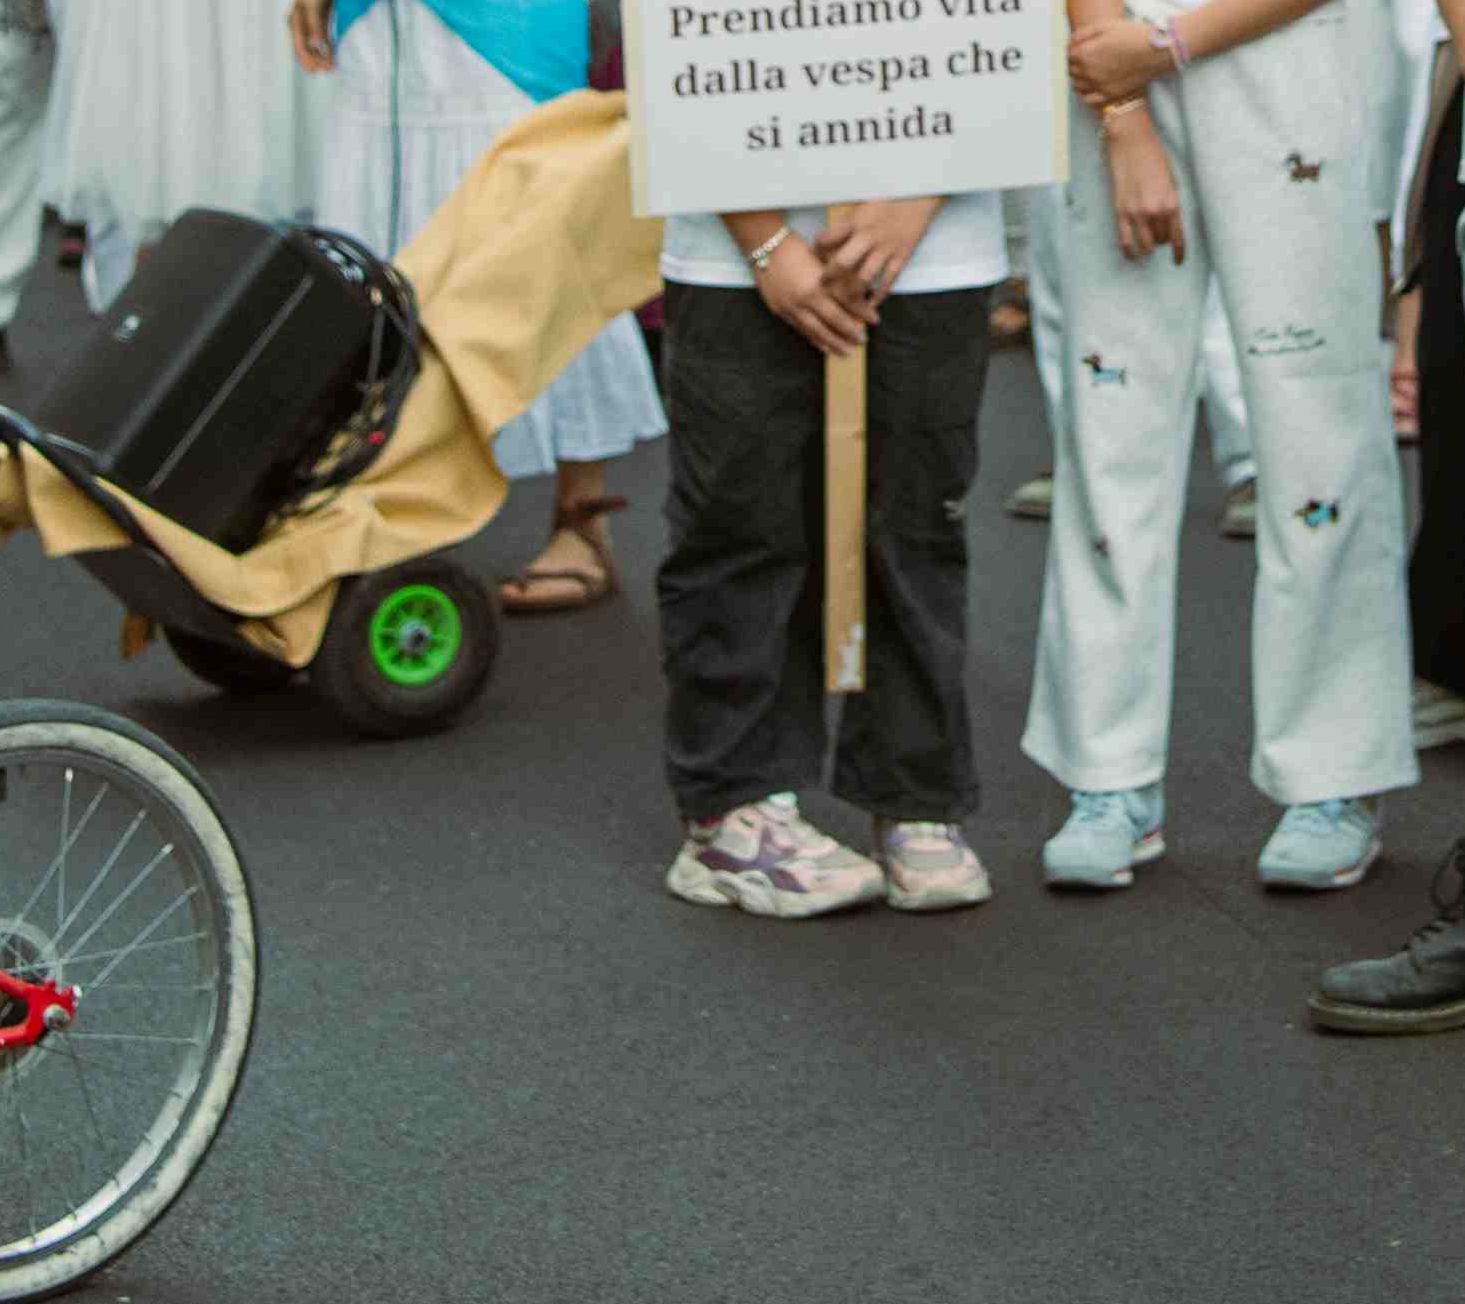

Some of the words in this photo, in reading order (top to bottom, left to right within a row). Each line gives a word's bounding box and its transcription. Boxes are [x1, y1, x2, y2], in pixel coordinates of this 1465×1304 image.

[673, 58, 786, 98] dalla
[802, 55, 931, 93] vespa
[946, 41, 1024, 76] che
[746, 115, 782, 150] si
[798, 105, 954, 147] annida
